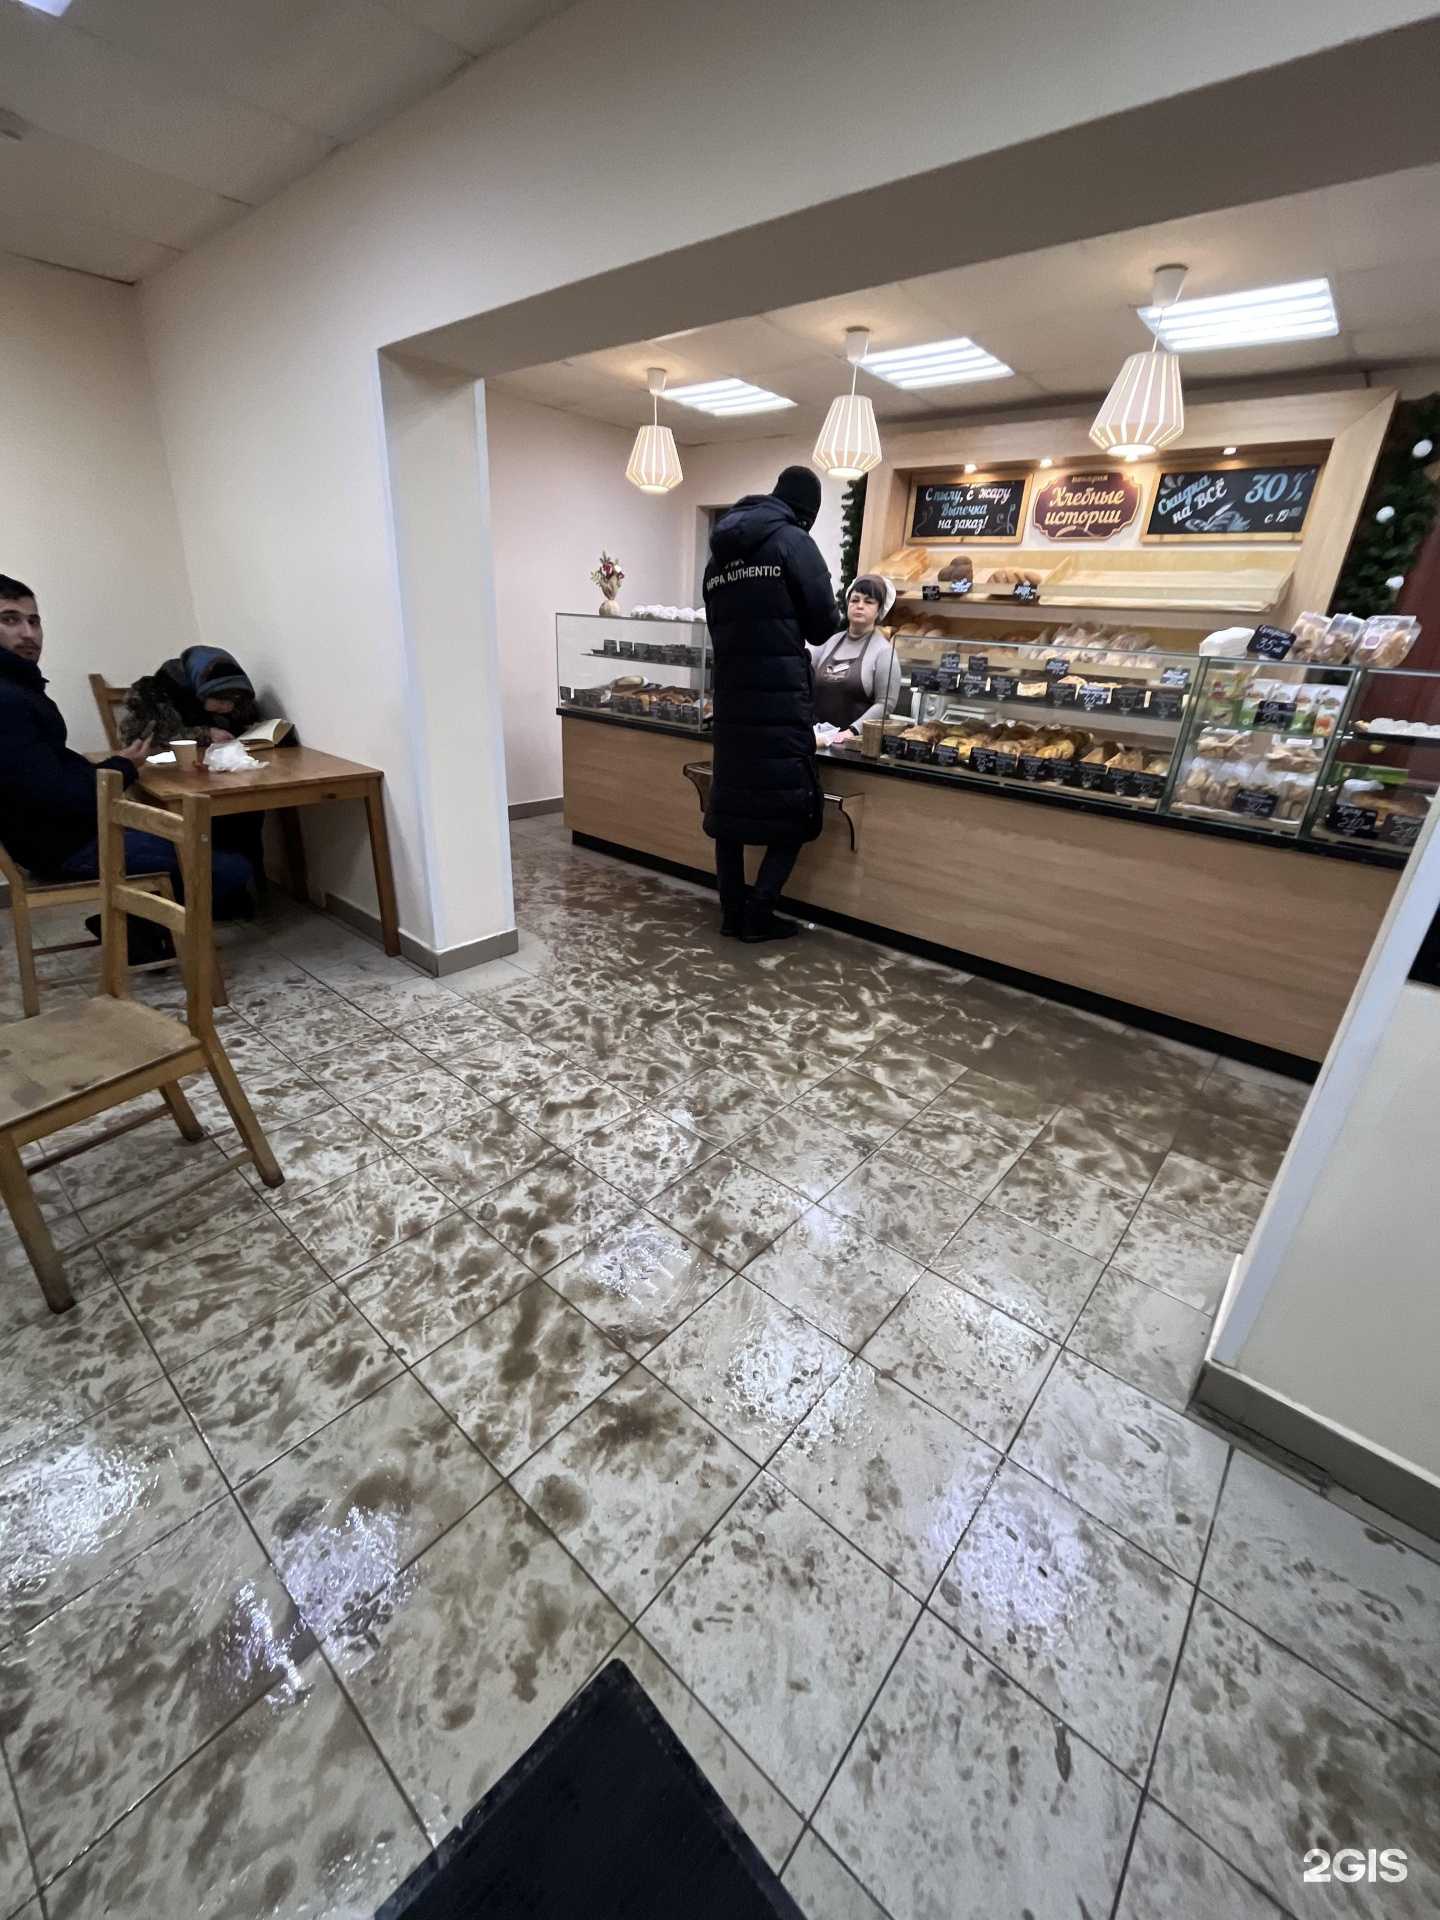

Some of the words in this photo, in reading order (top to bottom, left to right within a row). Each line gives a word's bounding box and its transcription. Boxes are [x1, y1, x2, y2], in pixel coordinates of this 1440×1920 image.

[978, 487, 1012, 504] жару
[1049, 486, 1125, 508] Хлебные
[1157, 474, 1212, 515] Скидка
[941, 503, 988, 516] Выпечка
[1172, 505, 1193, 524] на
[937, 519, 951, 529] на
[951, 515, 988, 535] заказ!
[1044, 509, 1121, 532] истории
[727, 565, 781, 582] AUTHENTIC
